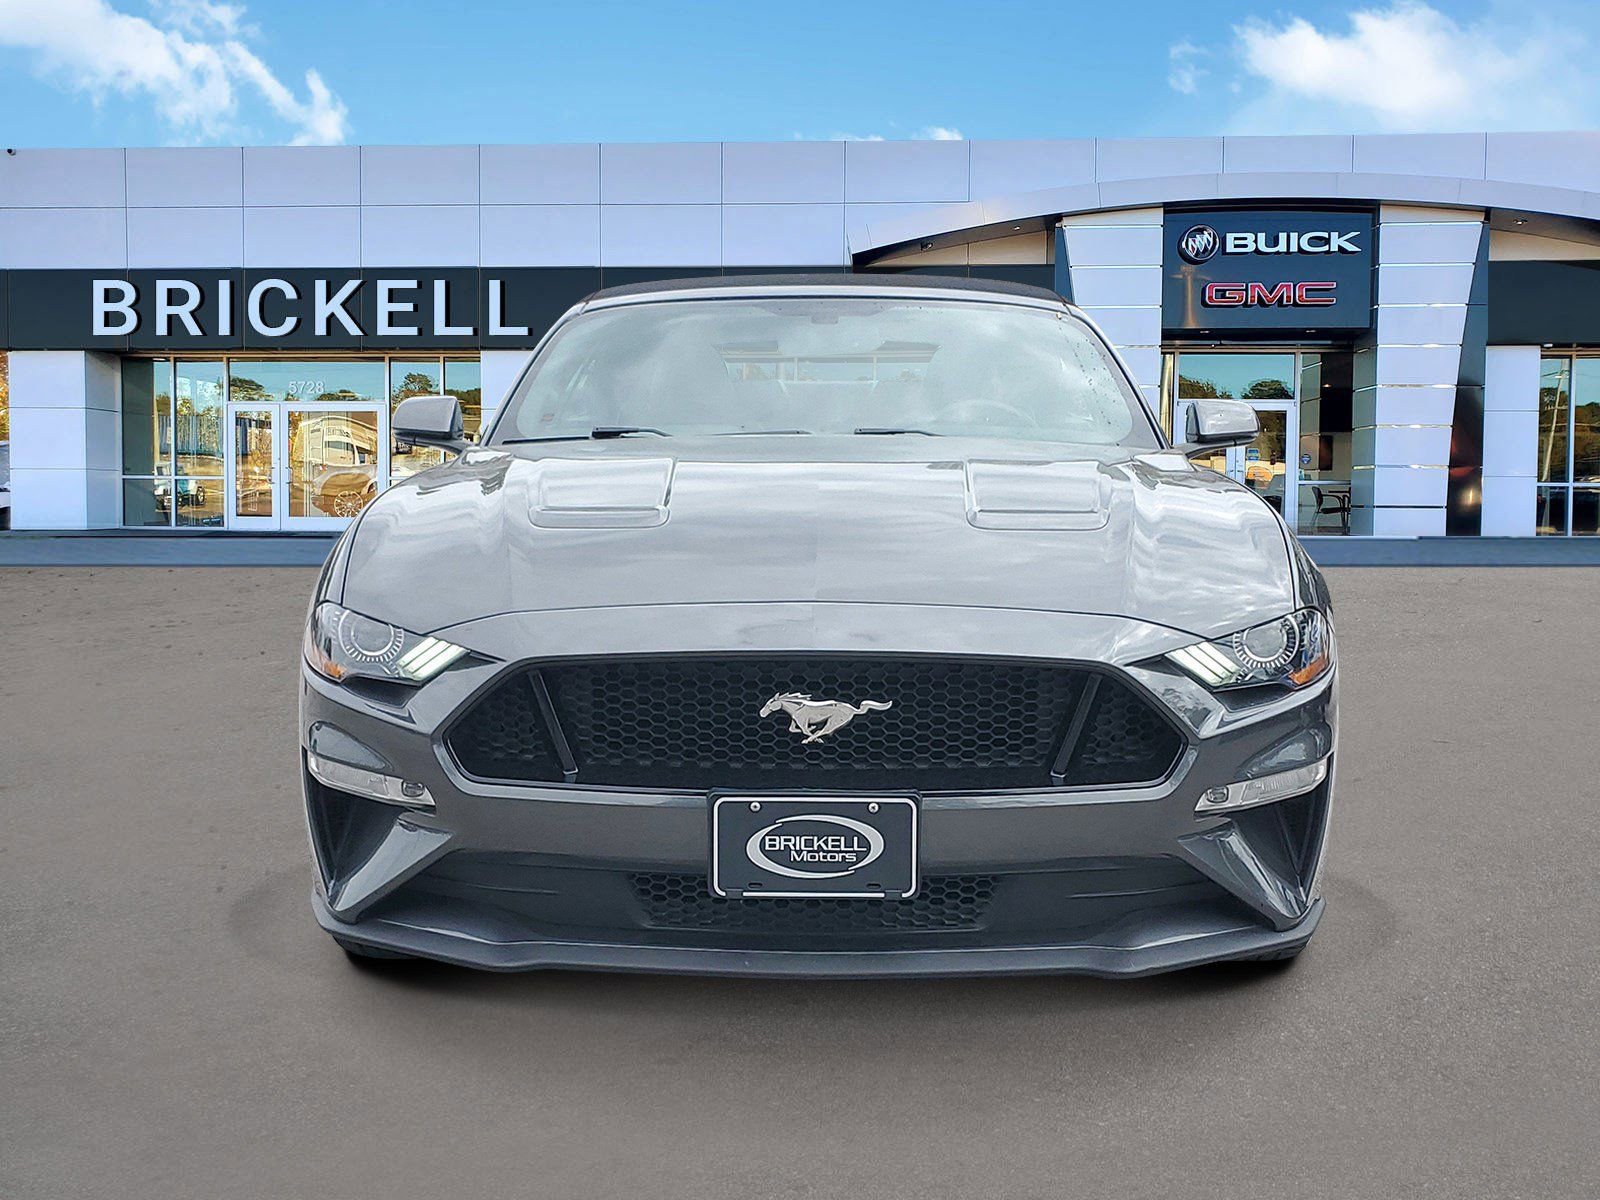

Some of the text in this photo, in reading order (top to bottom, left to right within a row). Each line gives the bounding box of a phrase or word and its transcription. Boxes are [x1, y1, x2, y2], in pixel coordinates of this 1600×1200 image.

[1225, 231, 1362, 252] BUICK
[1206, 282, 1337, 305] GMC
[92, 278, 529, 336] BRICKELL
[288, 380, 325, 394] 5728
[764, 835, 868, 851] BRICKELL
[789, 851, 857, 862] Motors
